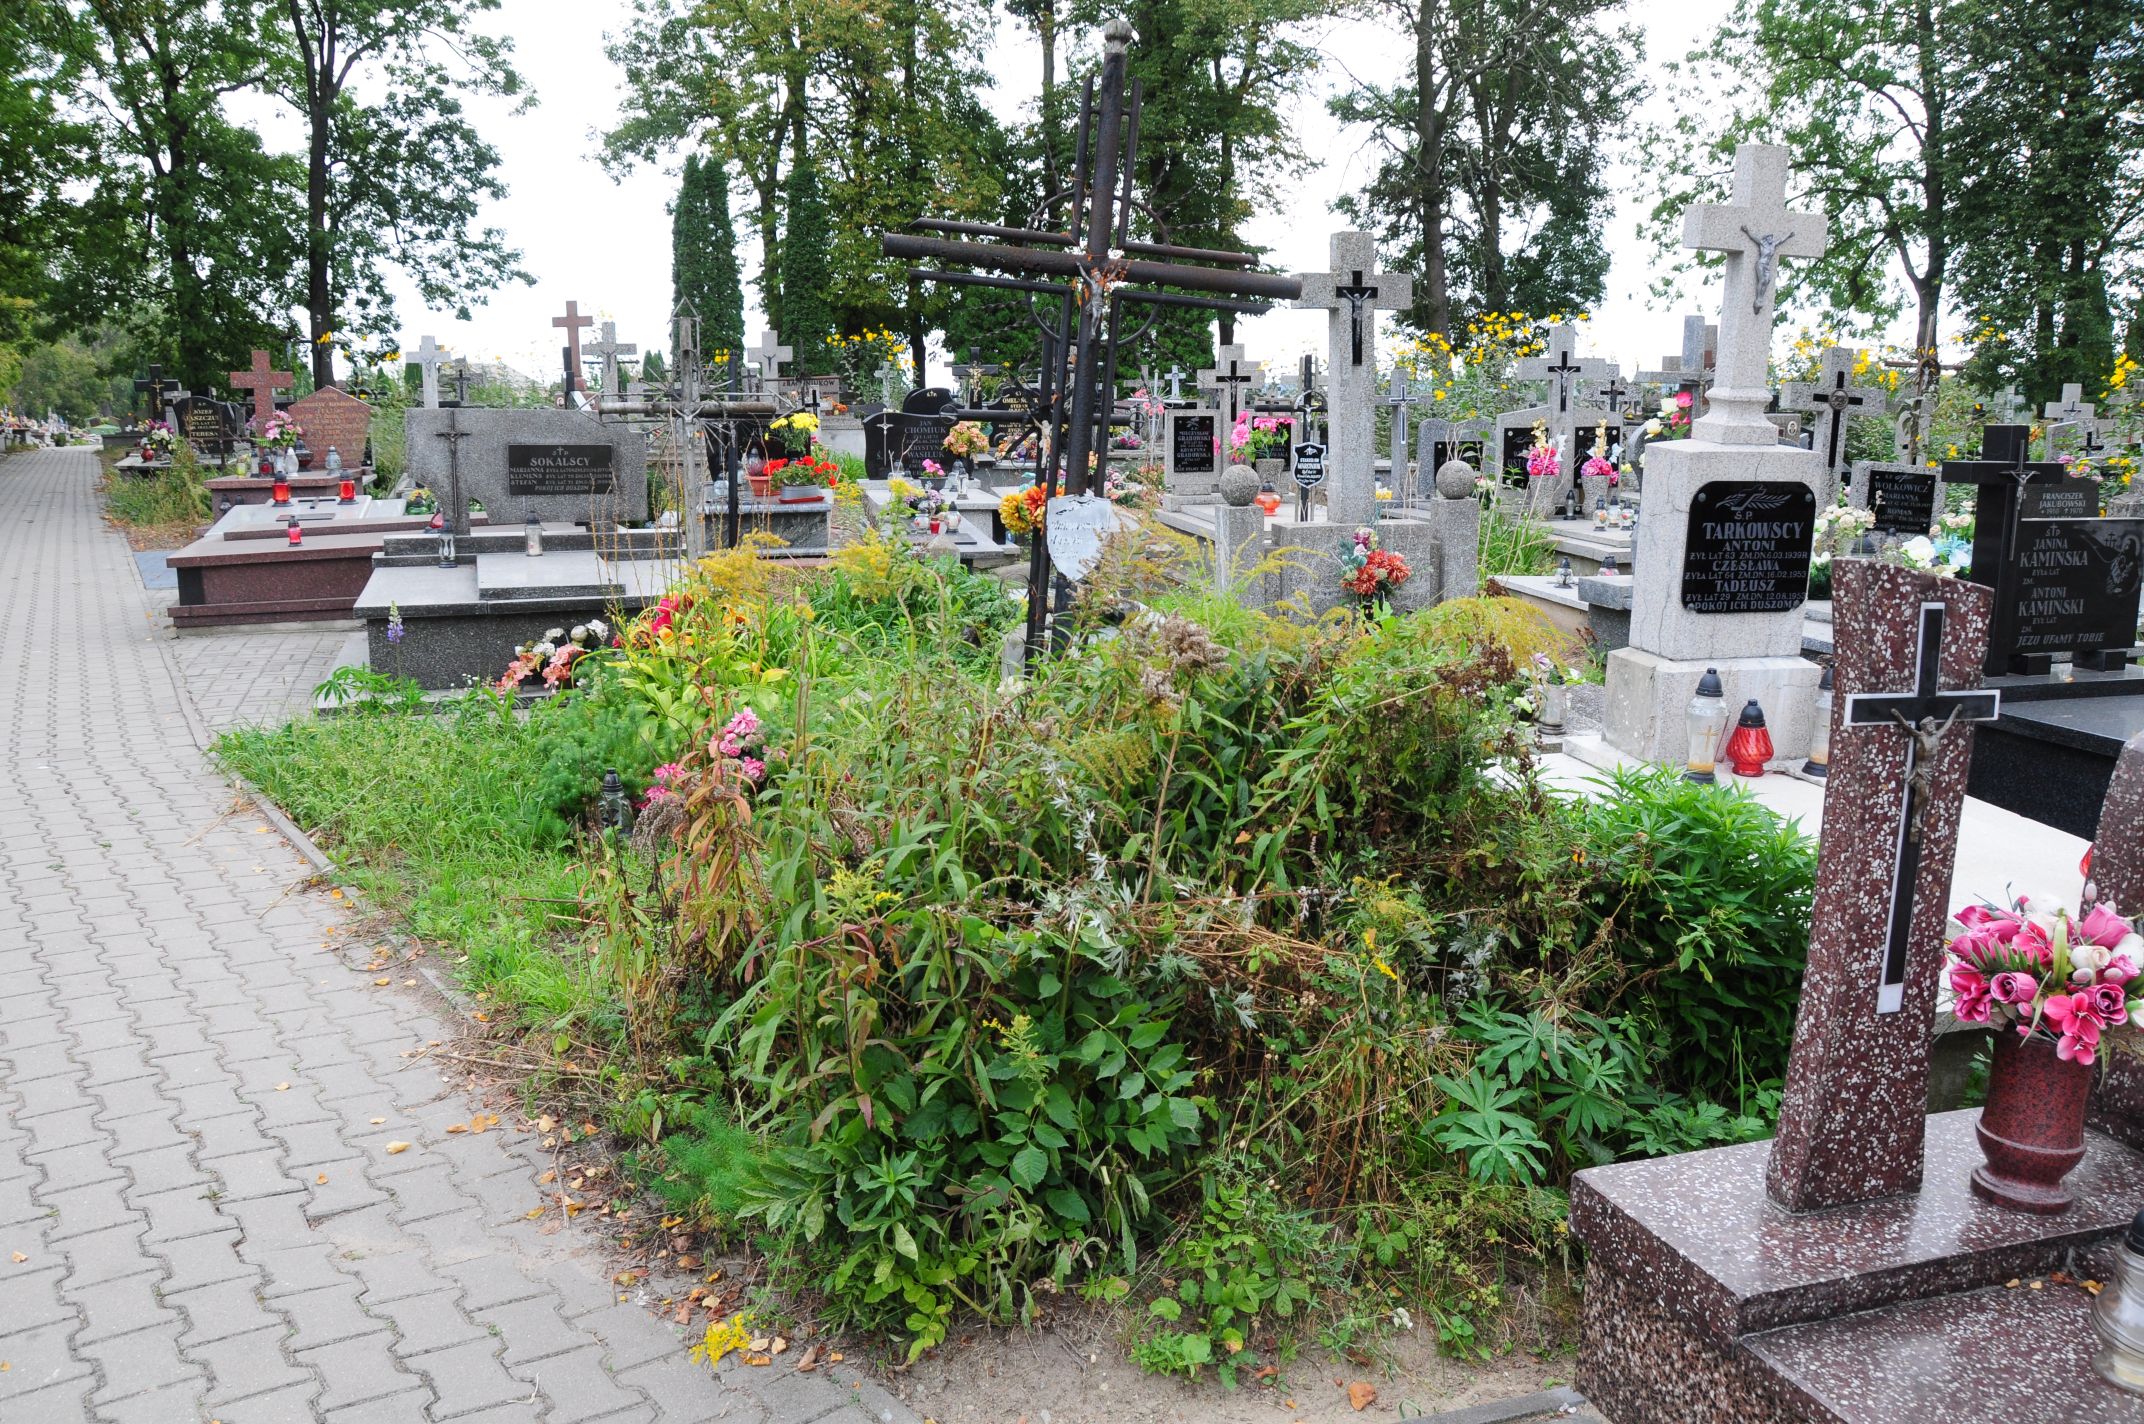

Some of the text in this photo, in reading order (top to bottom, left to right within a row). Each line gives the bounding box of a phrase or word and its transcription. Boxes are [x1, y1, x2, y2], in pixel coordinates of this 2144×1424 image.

[904, 426, 947, 434] CHOMIUK
[530, 457, 590, 467] SOKALSCY
[2042, 492, 2084, 500] FRANCISZEK
[2039, 499, 2087, 509] JAKUBOWSKI
[1702, 521, 1805, 540] TARKOWSCY
[1722, 540, 1776, 551] ANTONI
[2033, 538, 2069, 550] JANINA
[1708, 552, 1723, 560] LAT
[1712, 560, 1780, 572] CZESŁAWA
[1708, 571, 1723, 580] LAT
[1724, 571, 1735, 579] 64
[1715, 579, 1776, 593] TADEUSZ
[1704, 593, 1719, 601] LAT
[1720, 593, 1731, 601] 29
[2031, 586, 2067, 600] ANTONI
[1694, 599, 1793, 612] POKÓJ ICH DUSZOM
[2016, 631, 2106, 648] JEZU UFAMY TOBIE
